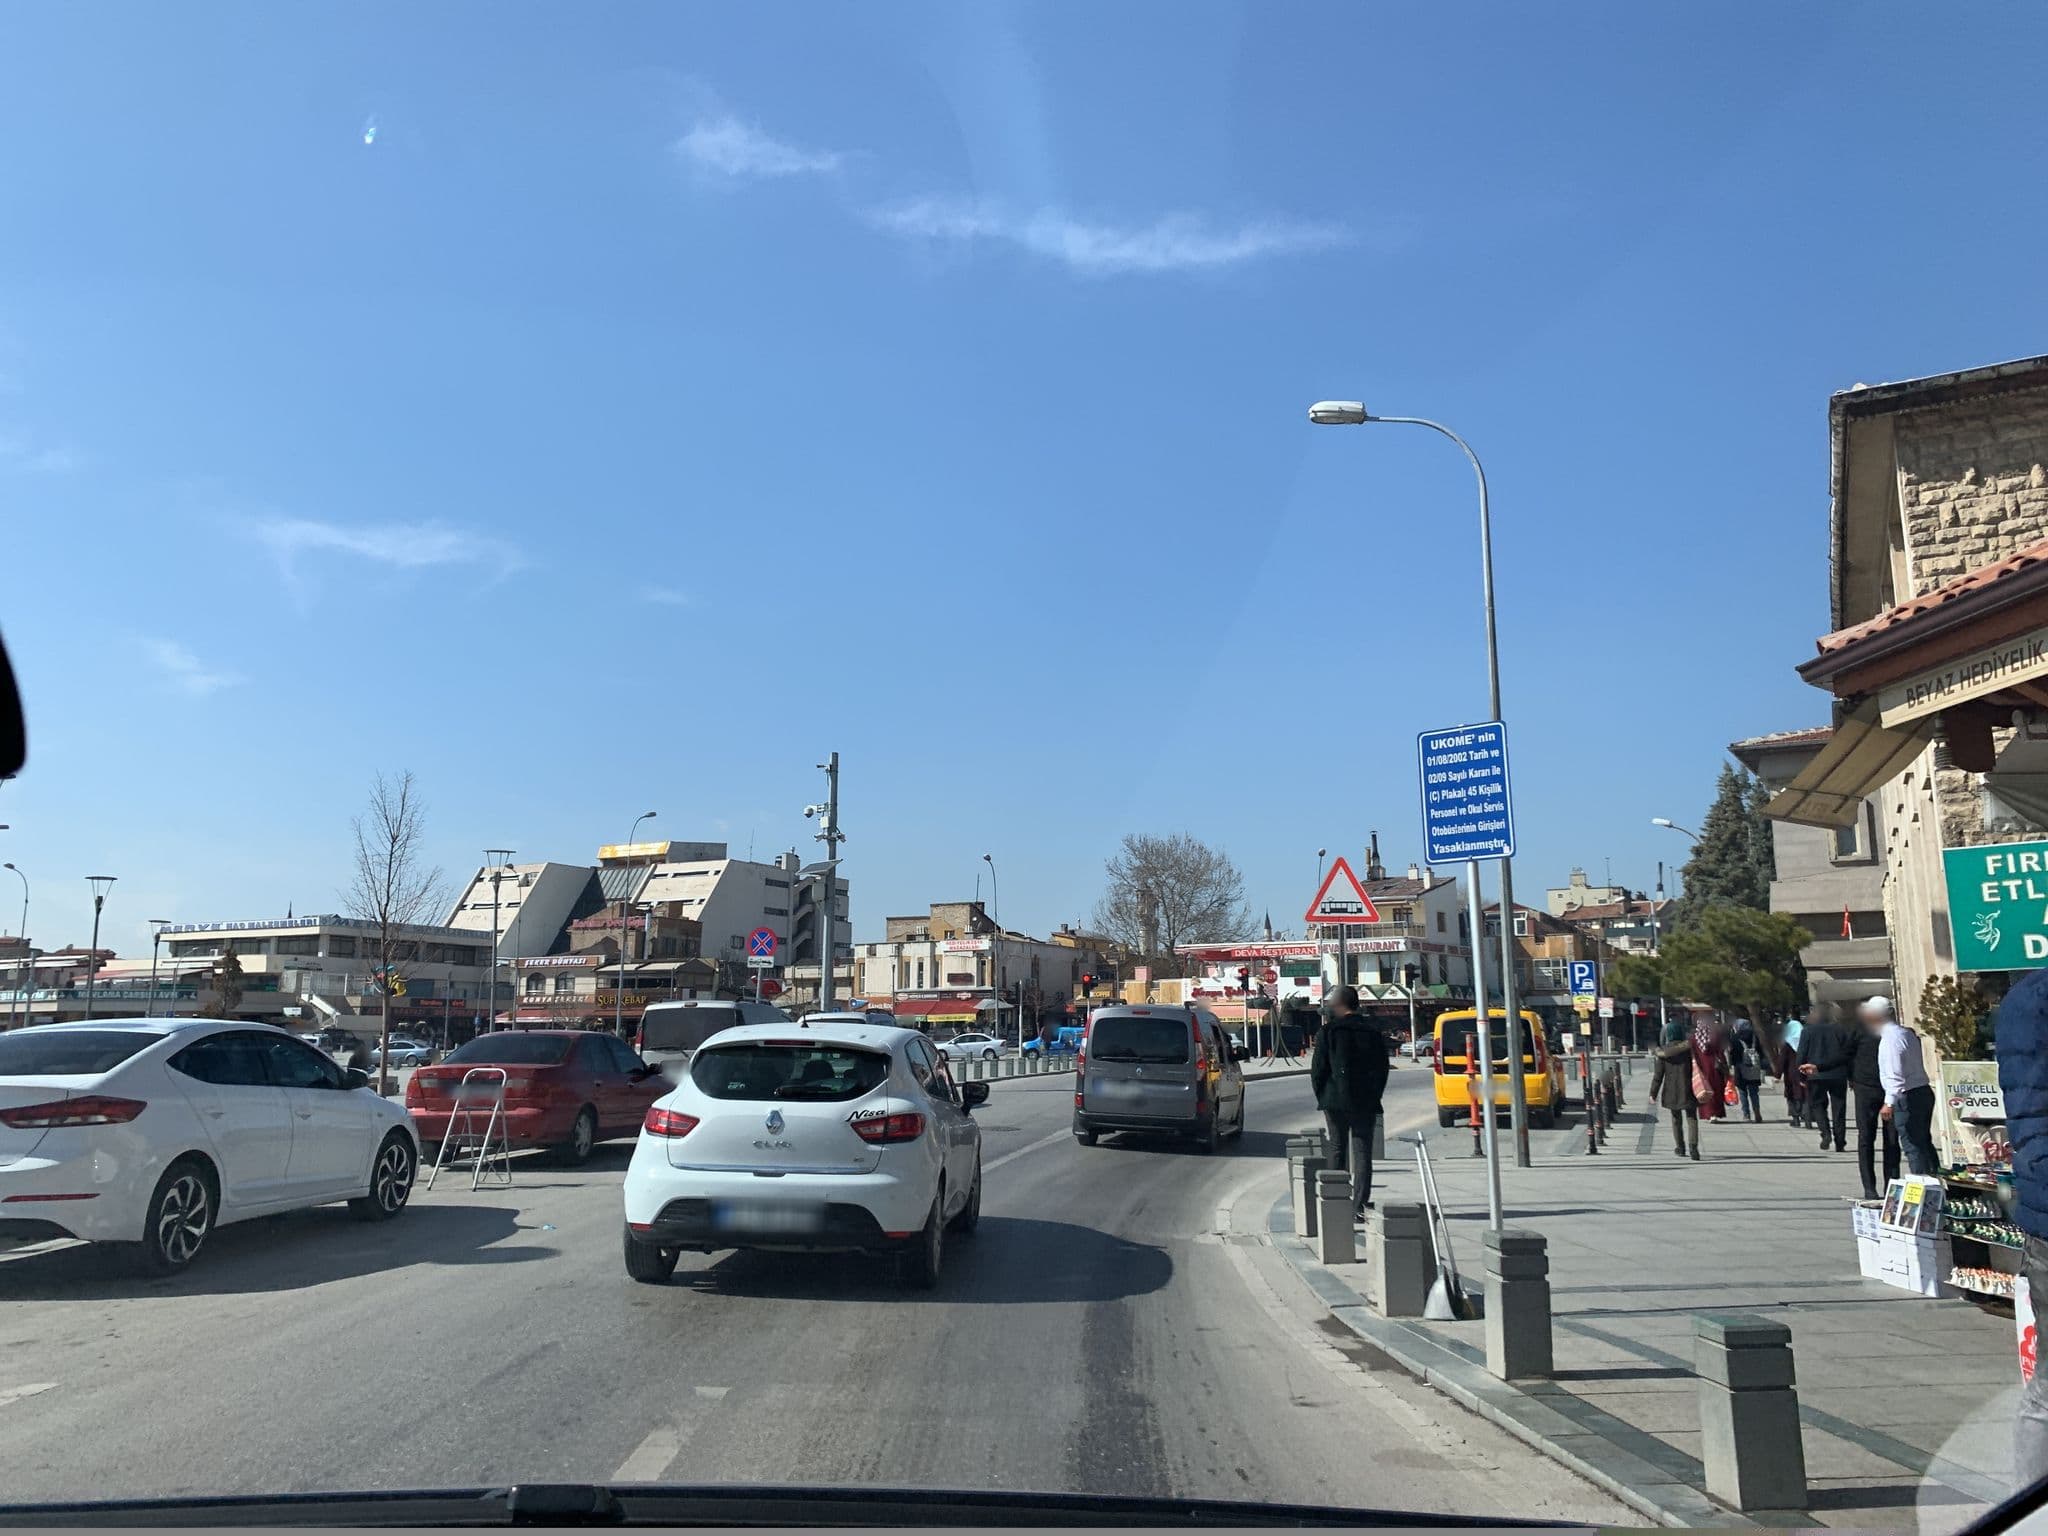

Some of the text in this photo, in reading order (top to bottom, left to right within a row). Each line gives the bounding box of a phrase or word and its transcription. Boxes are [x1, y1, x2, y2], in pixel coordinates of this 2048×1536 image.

[1906, 638, 2046, 709] BEYAZ HEDİYELİK
[1478, 732, 1496, 743] nin
[1427, 748, 1500, 766] 01/08/2002 Tarih ve
[1428, 771, 1447, 784] 02/09
[1448, 770, 1468, 783] Sayılı
[1491, 765, 1501, 775] ile
[1429, 783, 1503, 803] (C) Plakalı 45 Kişilik
[1430, 801, 1505, 819] Personel ve Okul Servis
[1431, 818, 1506, 837] Otobüslerinin Girişleri
[1234, 946, 1320, 957] DEVA RESTAURANT
[524, 959, 550, 968] ŞEKER
[1574, 963, 1590, 985] P
[1947, 1084, 1998, 1094] TURKCELL
[1965, 1097, 1999, 1107] avea
[846, 1109, 886, 1122] Nisa
